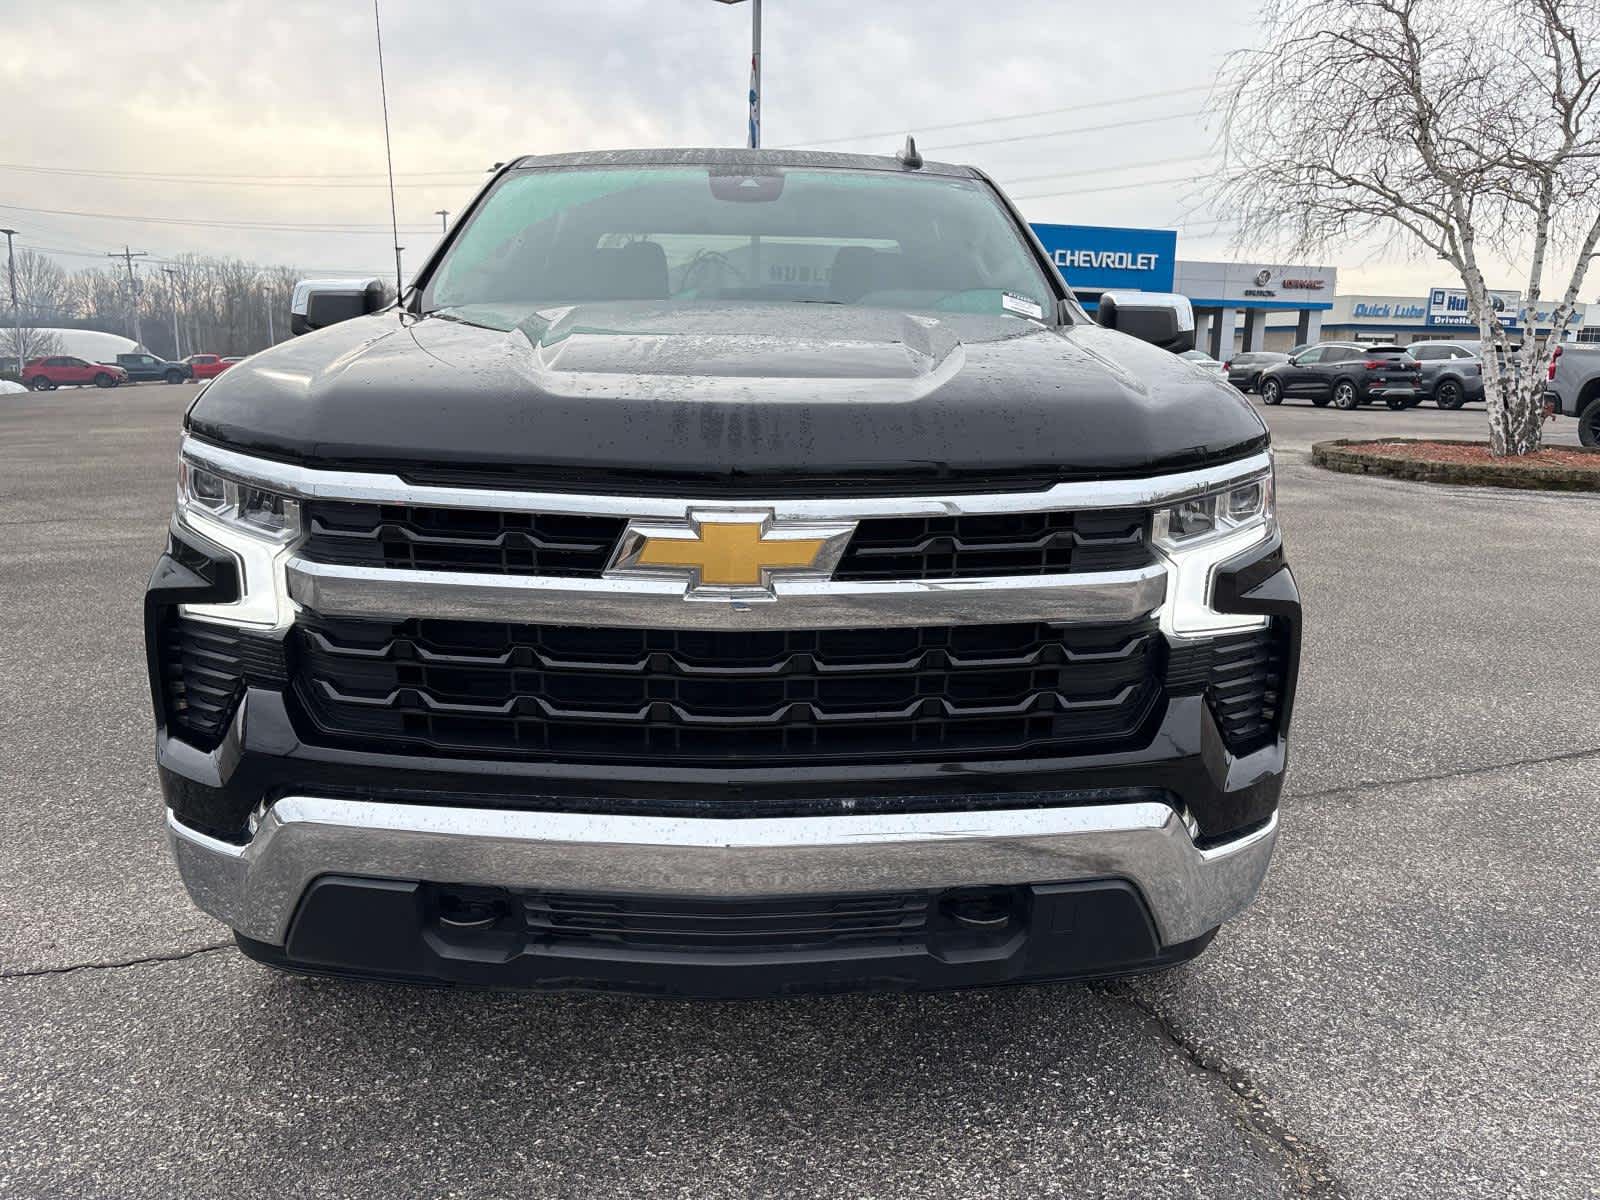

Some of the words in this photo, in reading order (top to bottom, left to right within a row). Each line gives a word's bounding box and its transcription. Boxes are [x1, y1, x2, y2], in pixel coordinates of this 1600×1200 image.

[1054, 249, 1159, 270] CHEVROLET
[768, 264, 833, 280] HUBLE
[1353, 303, 1391, 318] Quick
[1392, 304, 1426, 318] Lube
